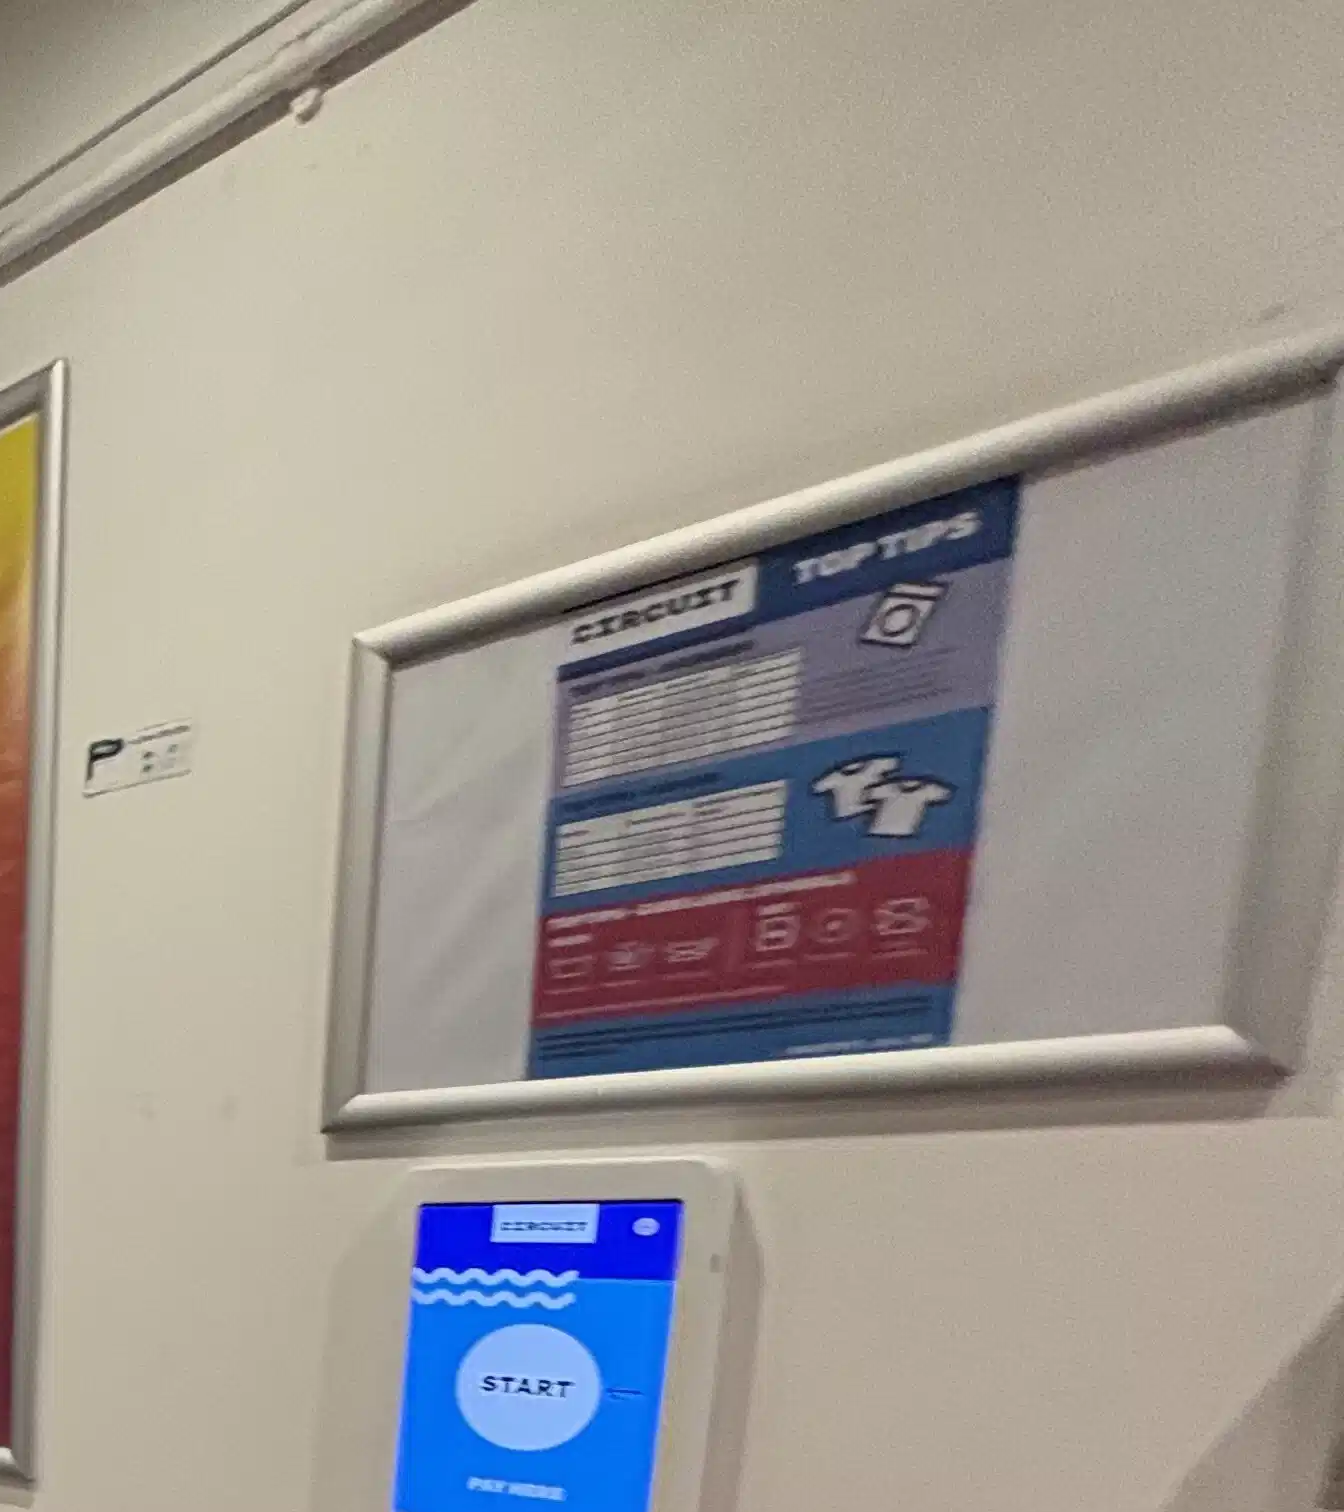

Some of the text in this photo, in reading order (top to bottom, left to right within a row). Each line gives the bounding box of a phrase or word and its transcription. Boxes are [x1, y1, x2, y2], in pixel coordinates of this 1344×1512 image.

[792, 510, 983, 585] TOP TIPS
[570, 578, 742, 647] CIRCUIT
[480, 1375, 576, 1399] START
